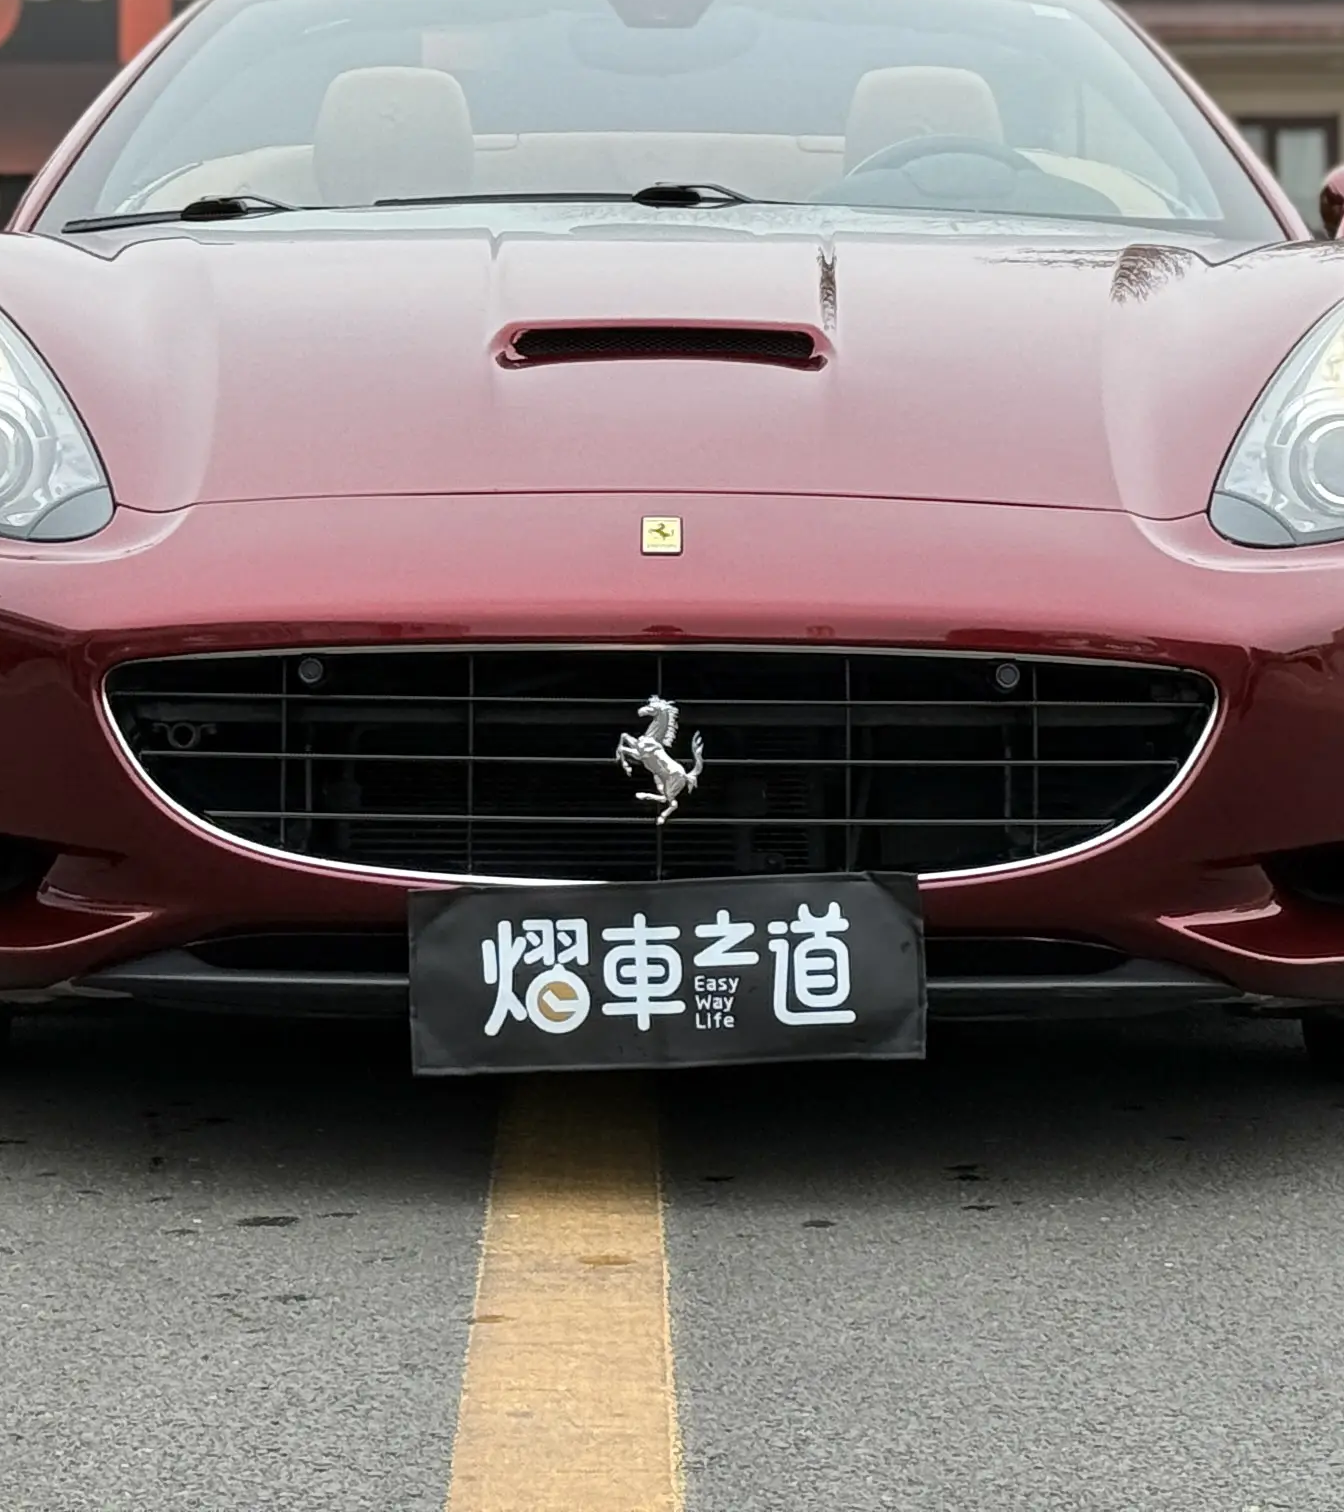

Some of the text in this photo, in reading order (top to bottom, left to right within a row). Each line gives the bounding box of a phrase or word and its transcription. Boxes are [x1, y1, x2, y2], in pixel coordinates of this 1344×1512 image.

[694, 975, 739, 994] Easy
[695, 994, 734, 1012] Way
[696, 1012, 735, 1029] Life
